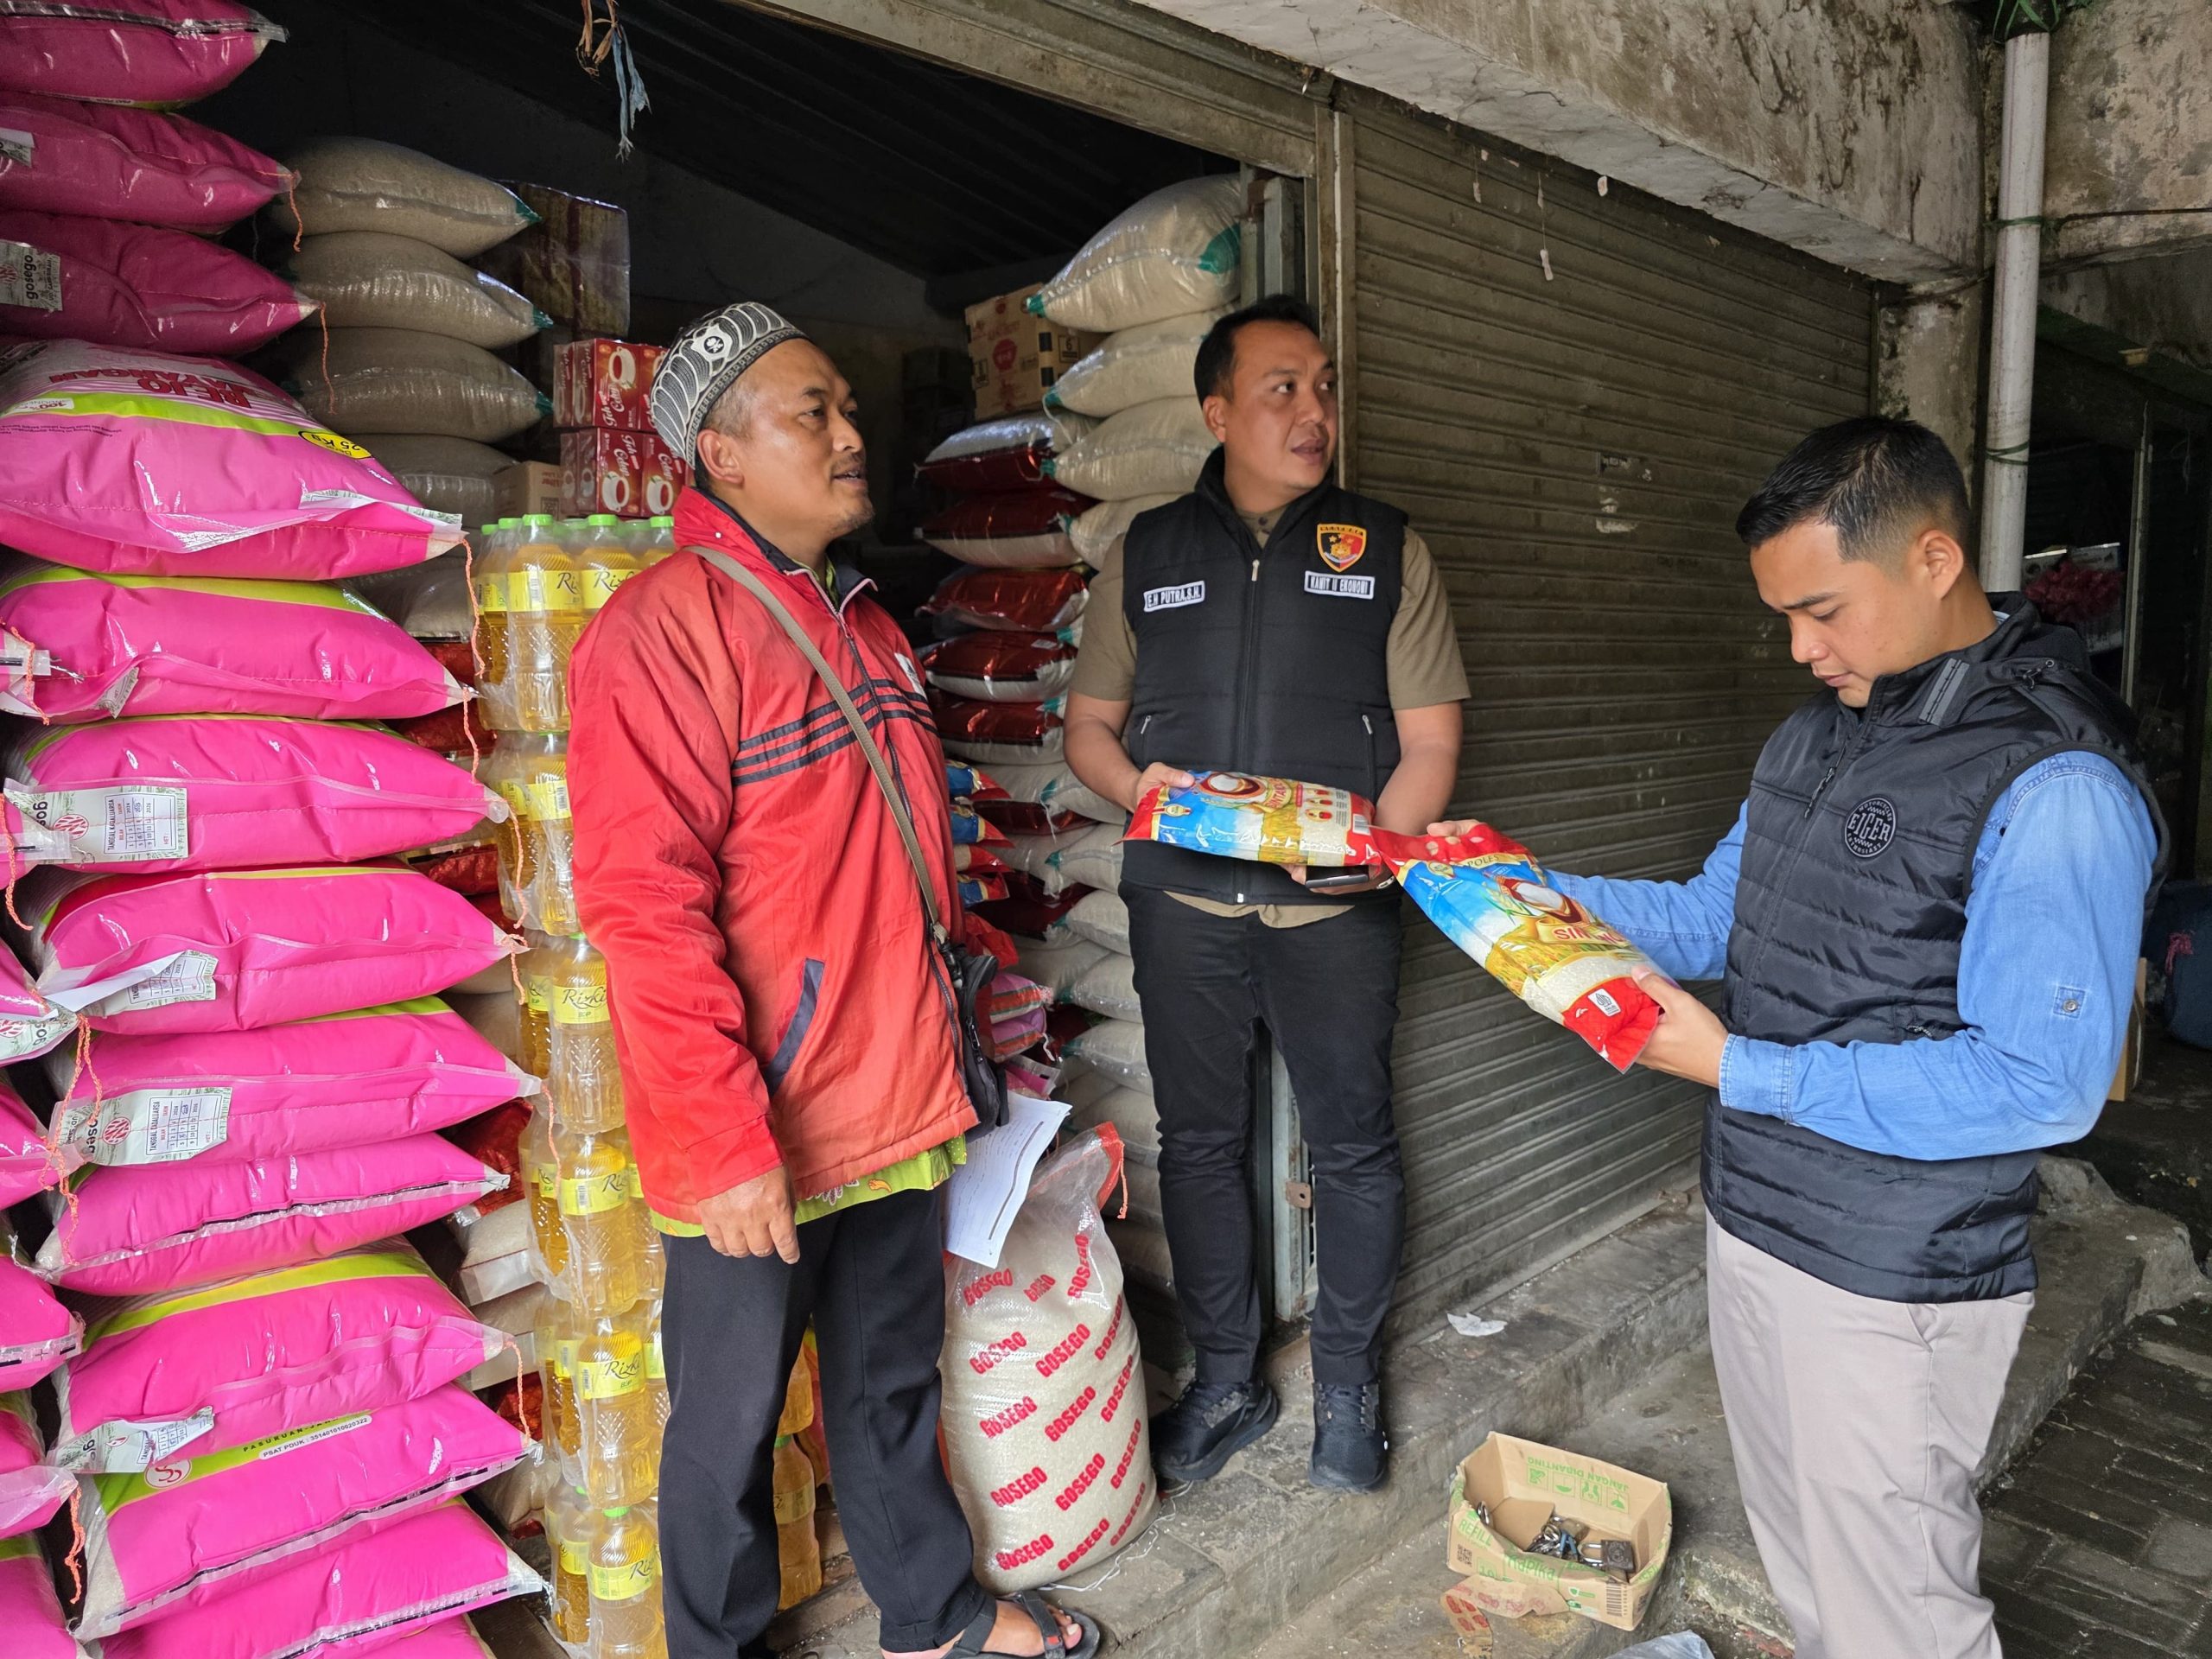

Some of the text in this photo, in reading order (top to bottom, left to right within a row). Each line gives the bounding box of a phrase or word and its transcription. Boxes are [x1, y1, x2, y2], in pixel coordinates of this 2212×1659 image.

[23, 254, 39, 300] gosego
[107, 830, 116, 850] TANGGAL
[1847, 812, 1891, 842] EIGER
[149, 1130, 158, 1151] TANGGAL
[969, 1331, 1027, 1375] GOSEGO
[1036, 1323, 1091, 1378] GOSEGO
[1099, 1354, 1134, 1423] GOSEGO
[978, 1395, 1038, 1439] GOSEGO
[1044, 1386, 1097, 1443] GOSEGO
[263, 1446, 283, 1458] PSAT
[283, 1439, 305, 1452] PDUK
[1109, 1418, 1141, 1490] GOSEGO
[989, 1465, 1049, 1507] GOSEGO
[1054, 1452, 1106, 1511] GOSEGO
[1109, 1482, 1146, 1547] GOSEGO
[1458, 1519, 1494, 1547] REFILL
[995, 1533, 1055, 1571] GOSEGO
[1057, 1517, 1109, 1571] GOSEGO
